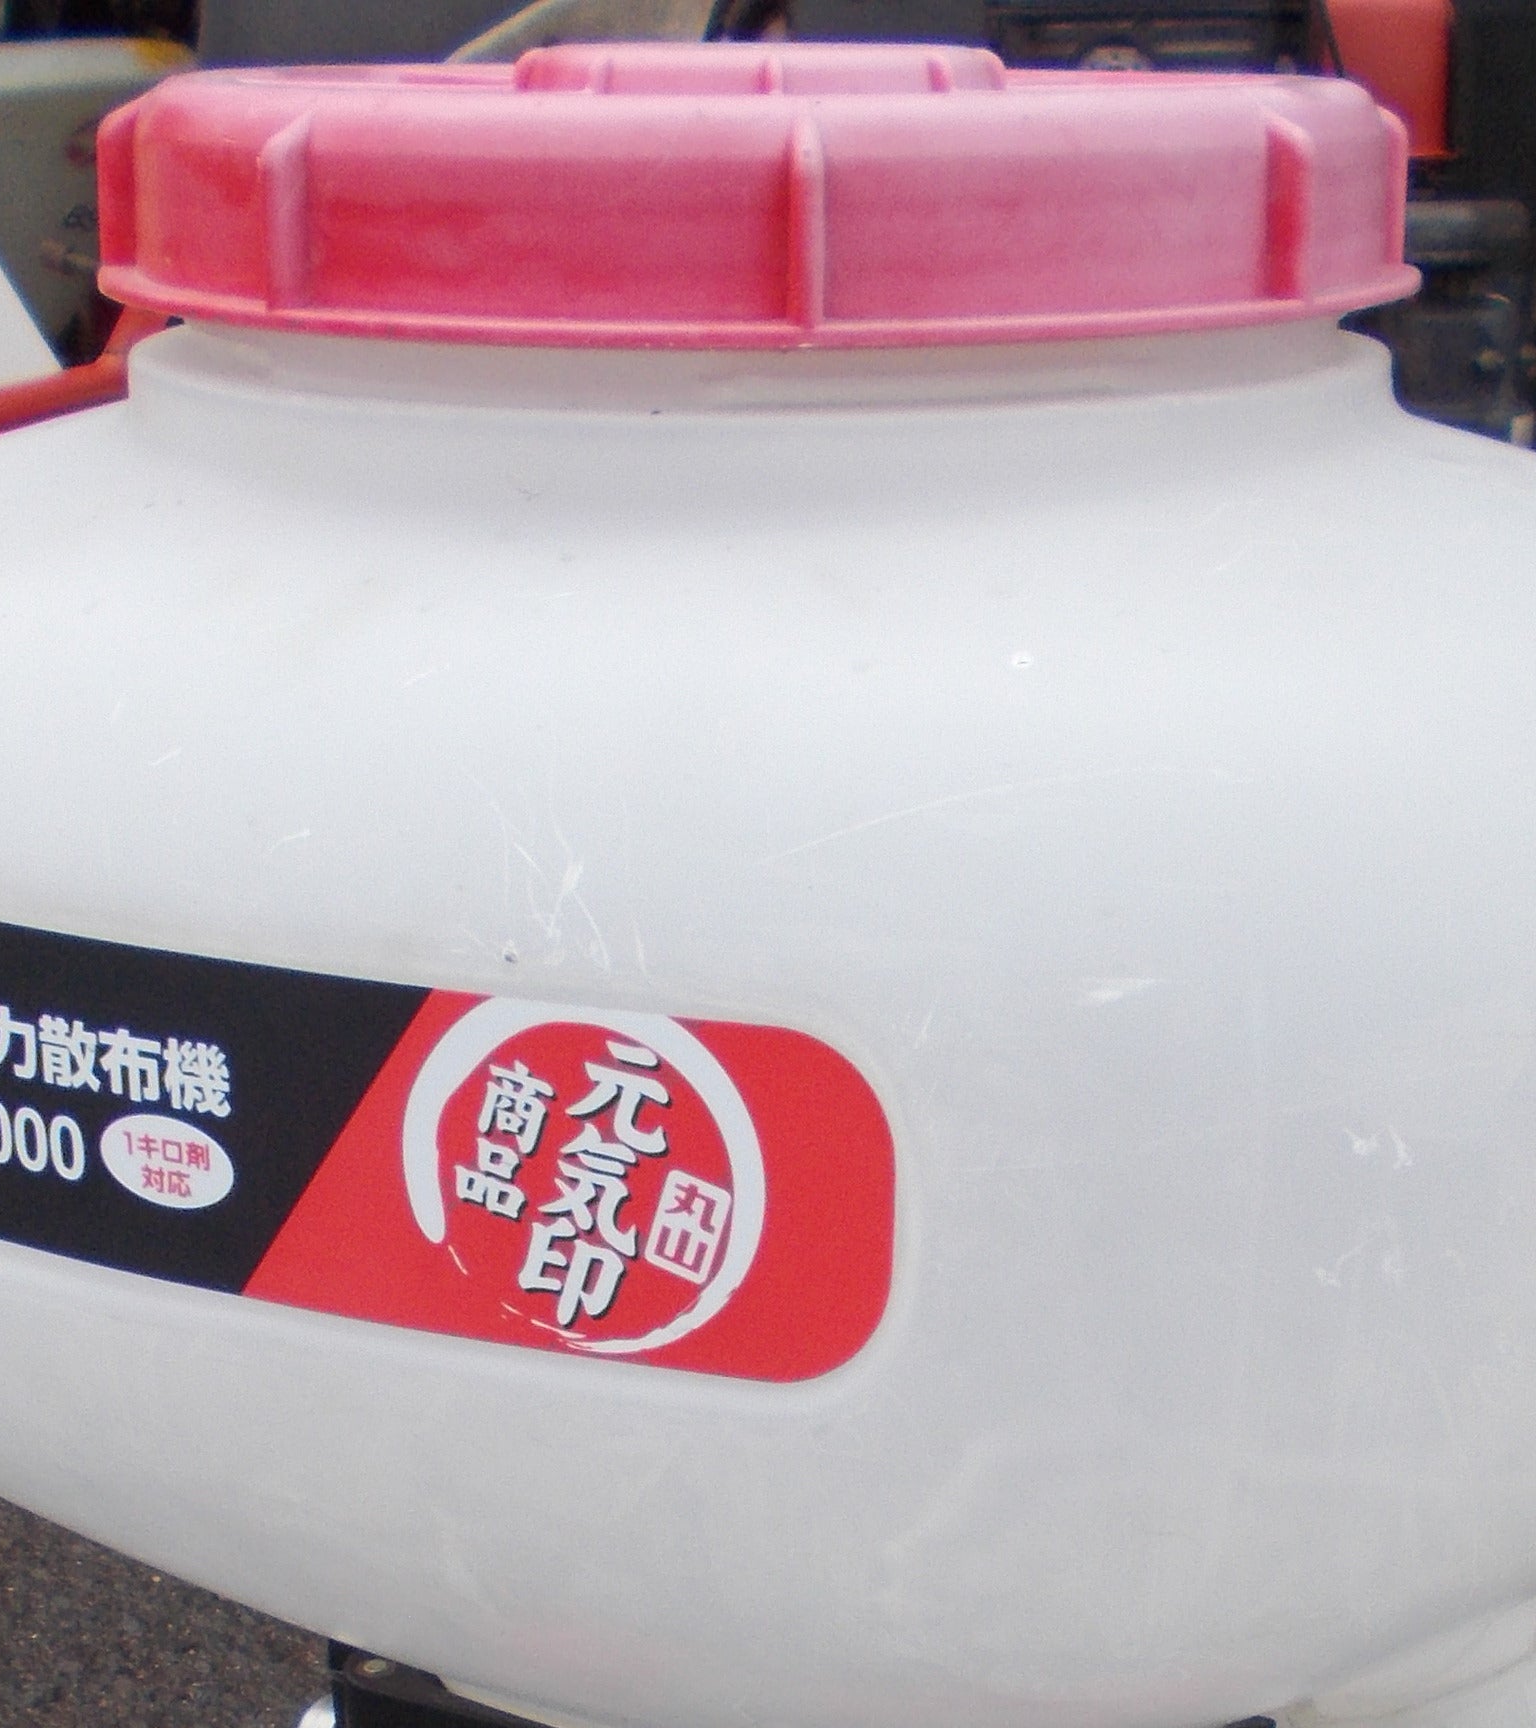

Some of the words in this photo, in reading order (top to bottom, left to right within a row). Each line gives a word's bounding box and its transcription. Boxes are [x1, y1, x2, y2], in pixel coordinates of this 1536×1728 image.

[121, 1131, 212, 1172] 1キロ剤
[141, 1164, 193, 1198] 対応
[455, 1060, 556, 1220] 商品
[518, 1040, 671, 1327] 元気印
